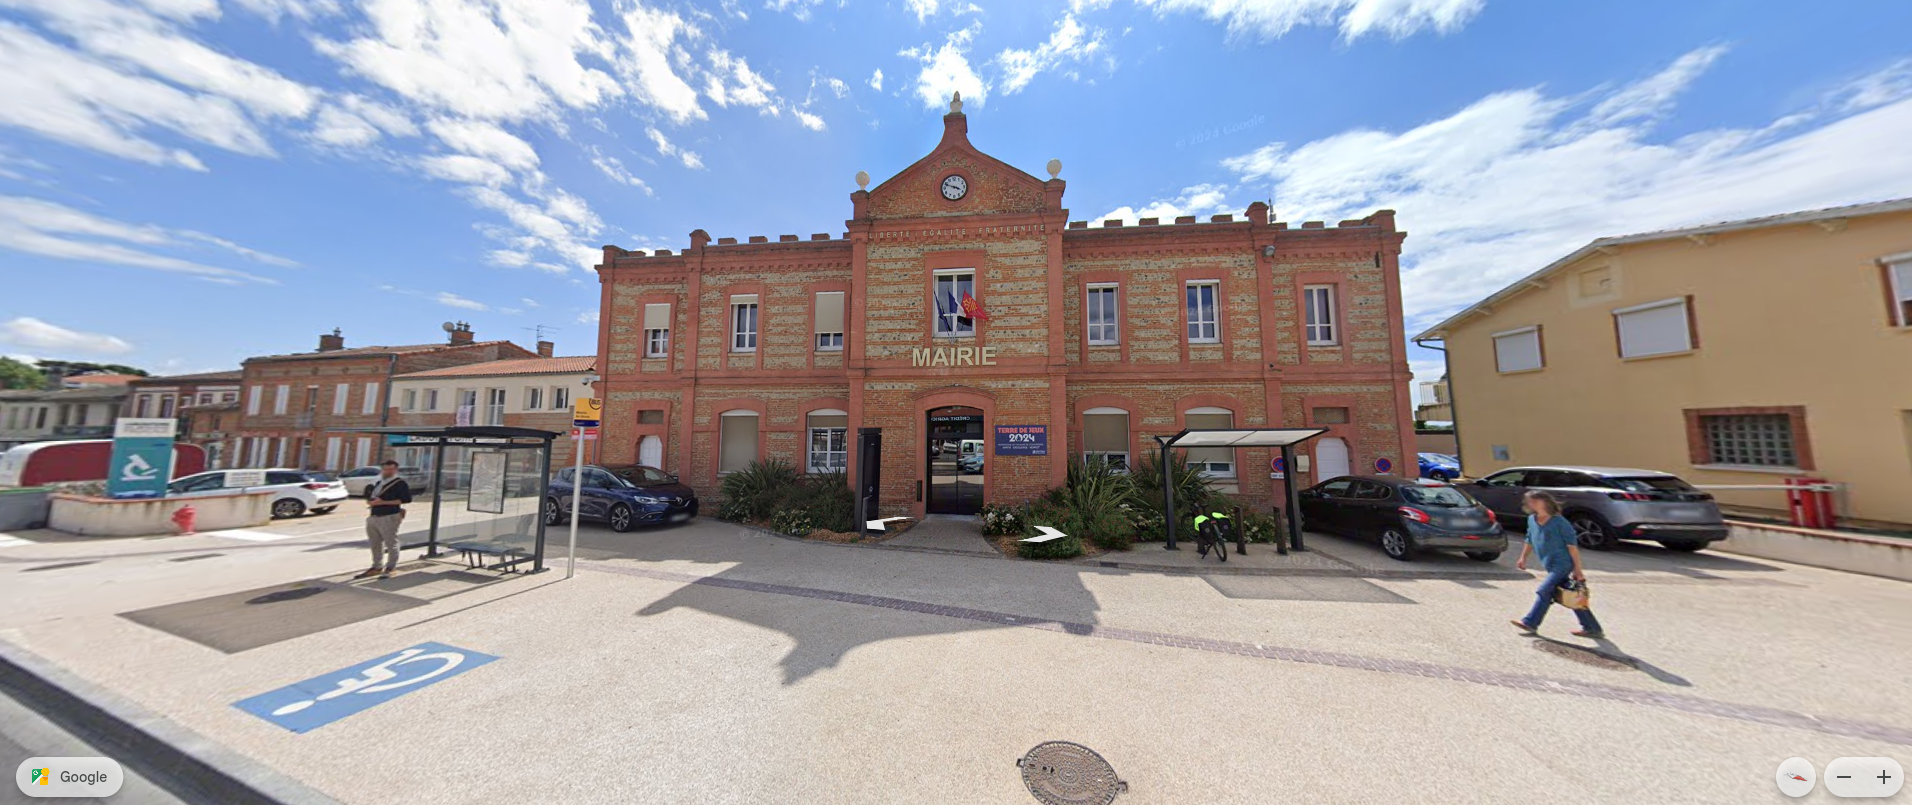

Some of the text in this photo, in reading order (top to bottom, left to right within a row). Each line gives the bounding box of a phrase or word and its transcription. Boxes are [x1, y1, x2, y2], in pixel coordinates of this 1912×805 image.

[978, 224, 1045, 235] FRATERNITE
[912, 346, 997, 367] MAIRIE
[1009, 433, 1035, 442] 2024
